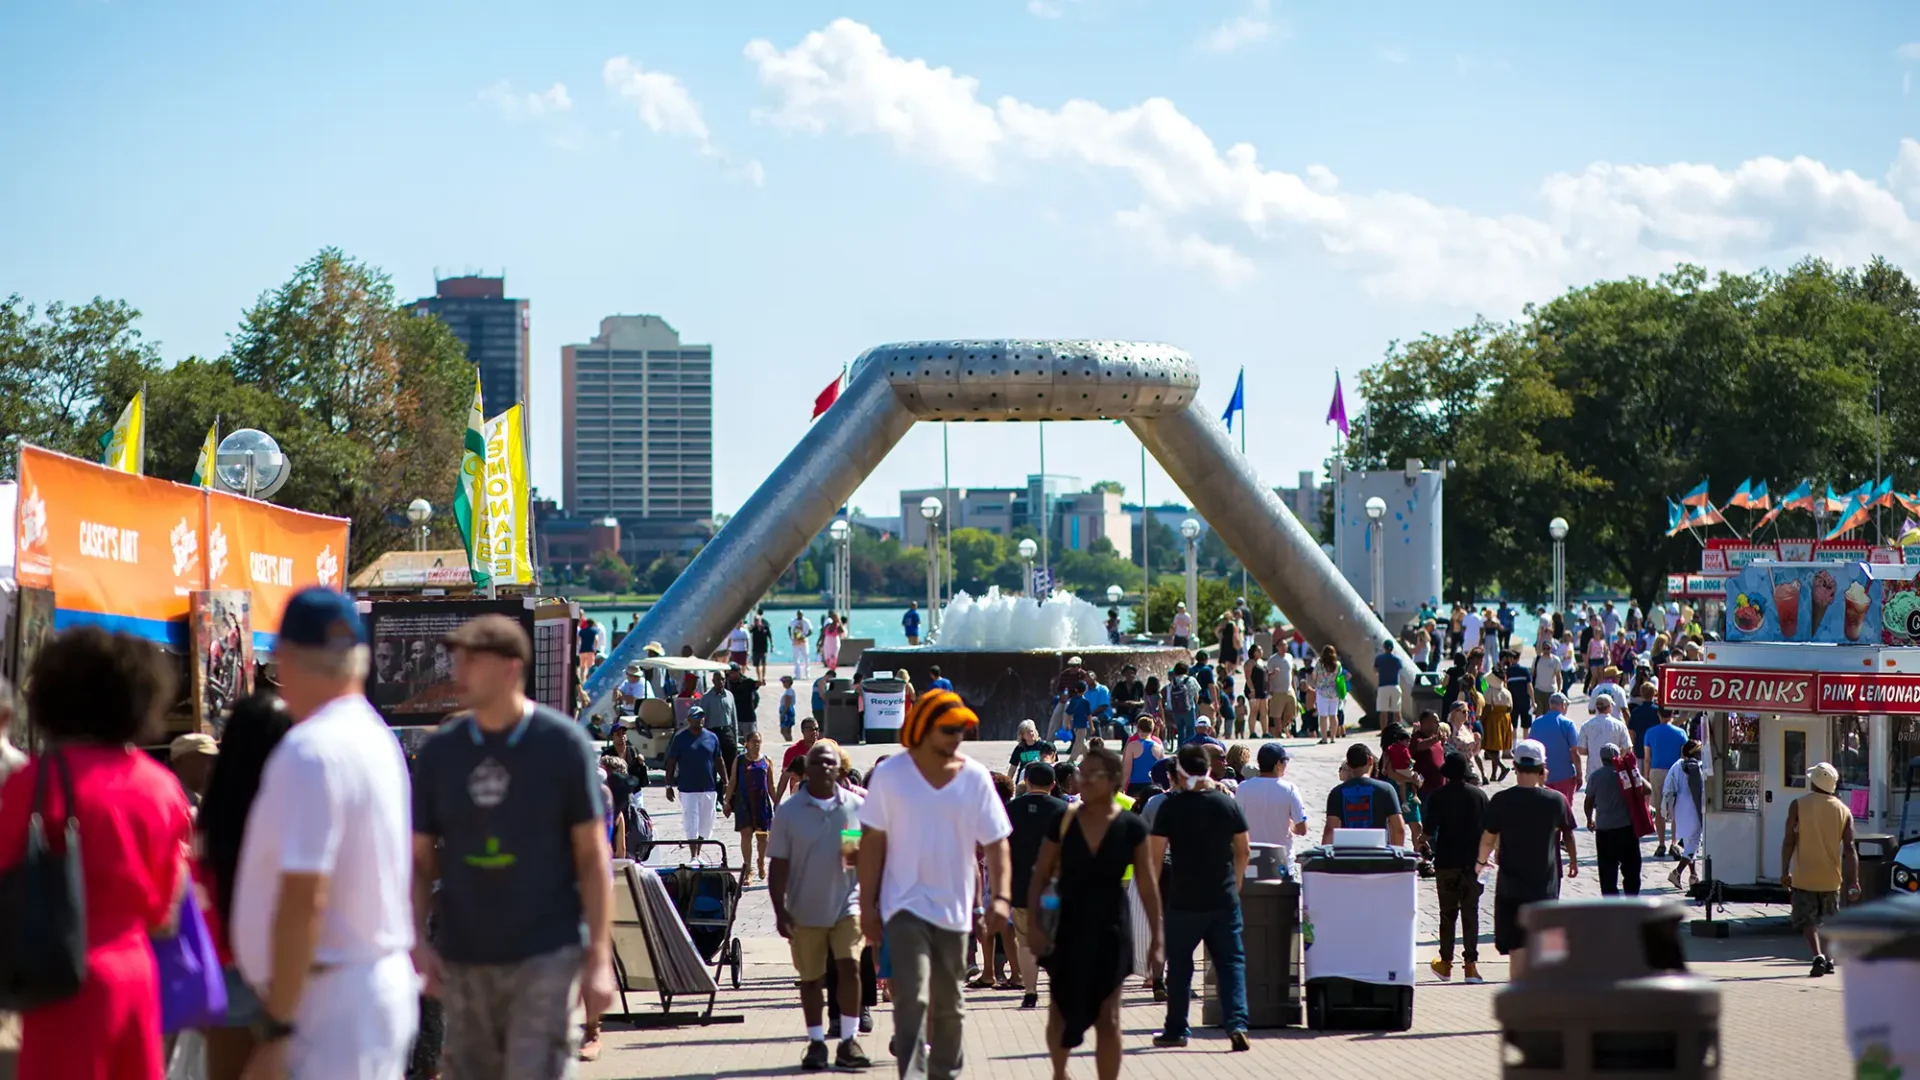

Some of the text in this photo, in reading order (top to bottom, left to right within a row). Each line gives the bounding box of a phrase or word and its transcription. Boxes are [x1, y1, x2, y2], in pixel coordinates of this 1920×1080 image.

[79, 520, 119, 561] CASEY'S
[120, 528, 139, 564] ART
[250, 551, 278, 586] CASEY'S
[279, 557, 294, 587] ART
[1689, 580, 1702, 590] HOT
[1704, 580, 1721, 590] DOGS
[1676, 675, 1697, 687] ICE
[1670, 688, 1702, 701] COLD
[1709, 678, 1808, 703] DRINKS
[1823, 683, 1920, 703] PINK LEMONAD
[1734, 788, 1759, 796] CREAM
